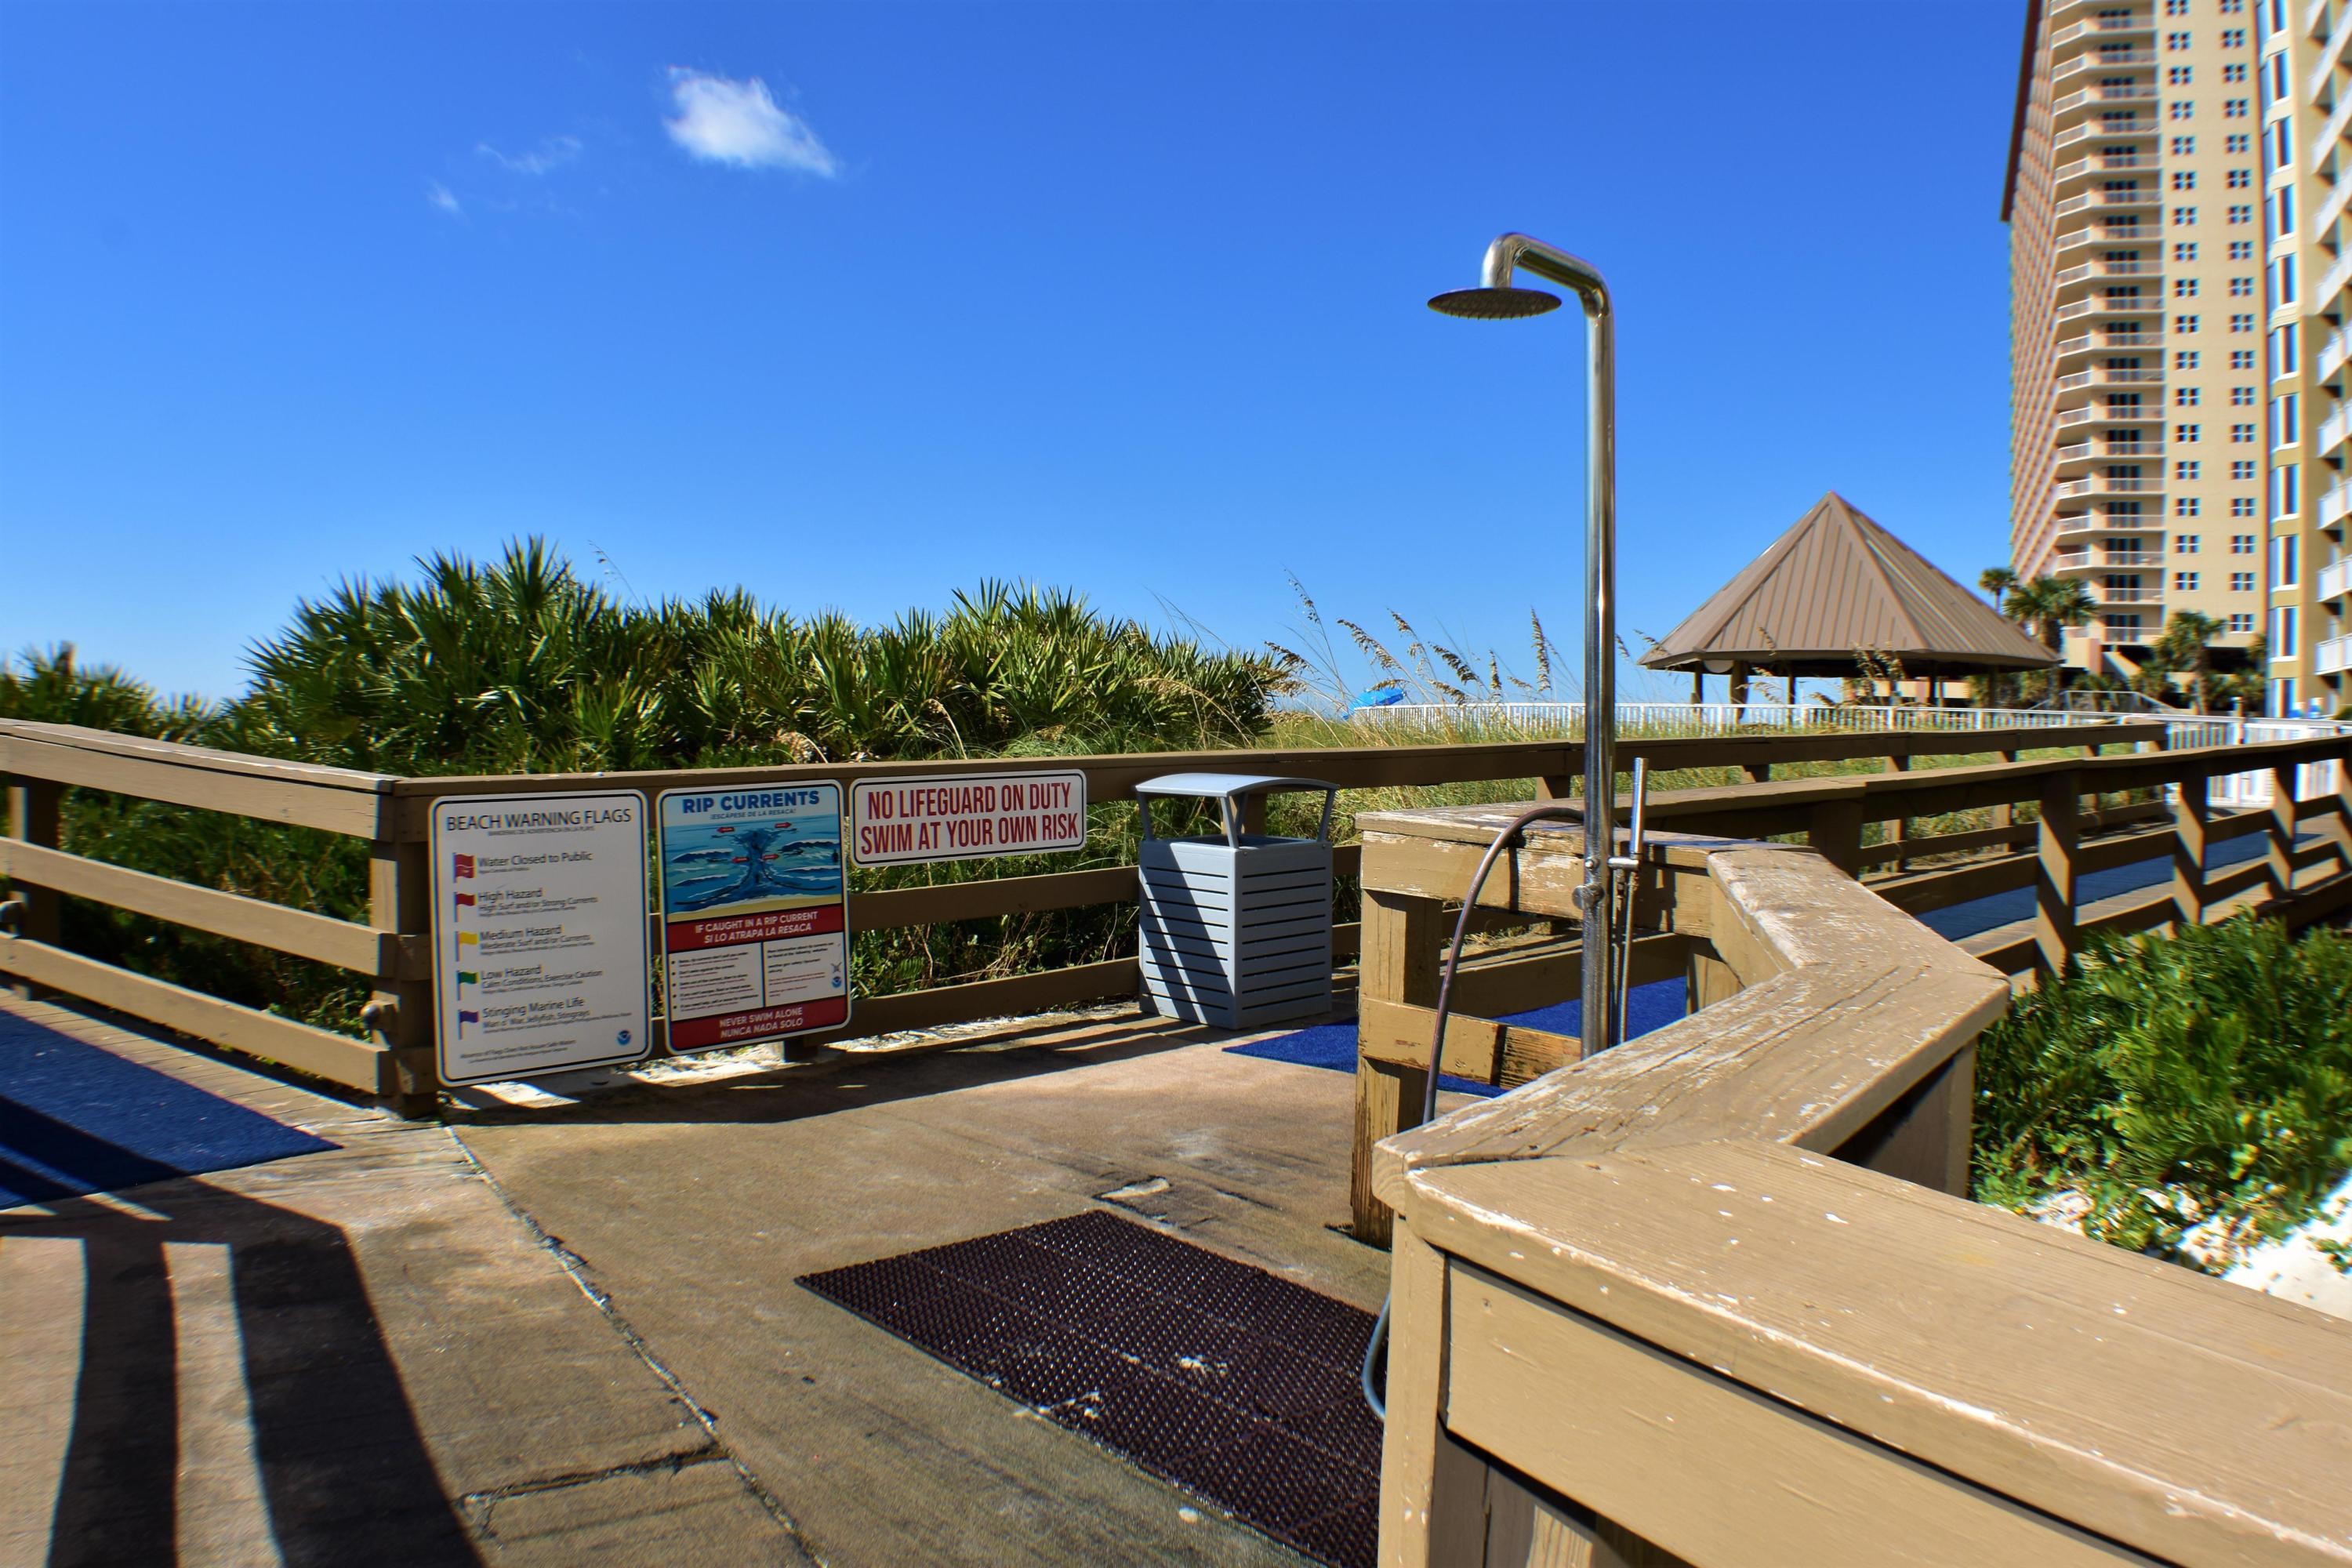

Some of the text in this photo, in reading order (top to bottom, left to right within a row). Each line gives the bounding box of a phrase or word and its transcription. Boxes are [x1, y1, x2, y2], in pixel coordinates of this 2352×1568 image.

[683, 790, 819, 813] RIP CURRENTS
[868, 782, 1071, 820] NO LIFEGUARD ON DUTY
[446, 808, 631, 830] BEACH WARNING FLAGS
[861, 812, 1079, 855] SWIM AT YOUR OWN RISK
[477, 851, 593, 867] Water Closed to Public
[478, 887, 543, 904] High Hazard
[479, 924, 562, 941] Medium Hazard
[695, 911, 818, 934] IF CAUGHT IN A RIP CURRENT
[704, 923, 812, 943] SI LO ATRAPA LA RESACA
[481, 965, 541, 980] Low Hazard
[482, 996, 585, 1018] Stinging Marine Life
[720, 1007, 803, 1028] NEVER SWIM ALONE
[720, 1018, 803, 1039] NUNCA NADA SOLO
